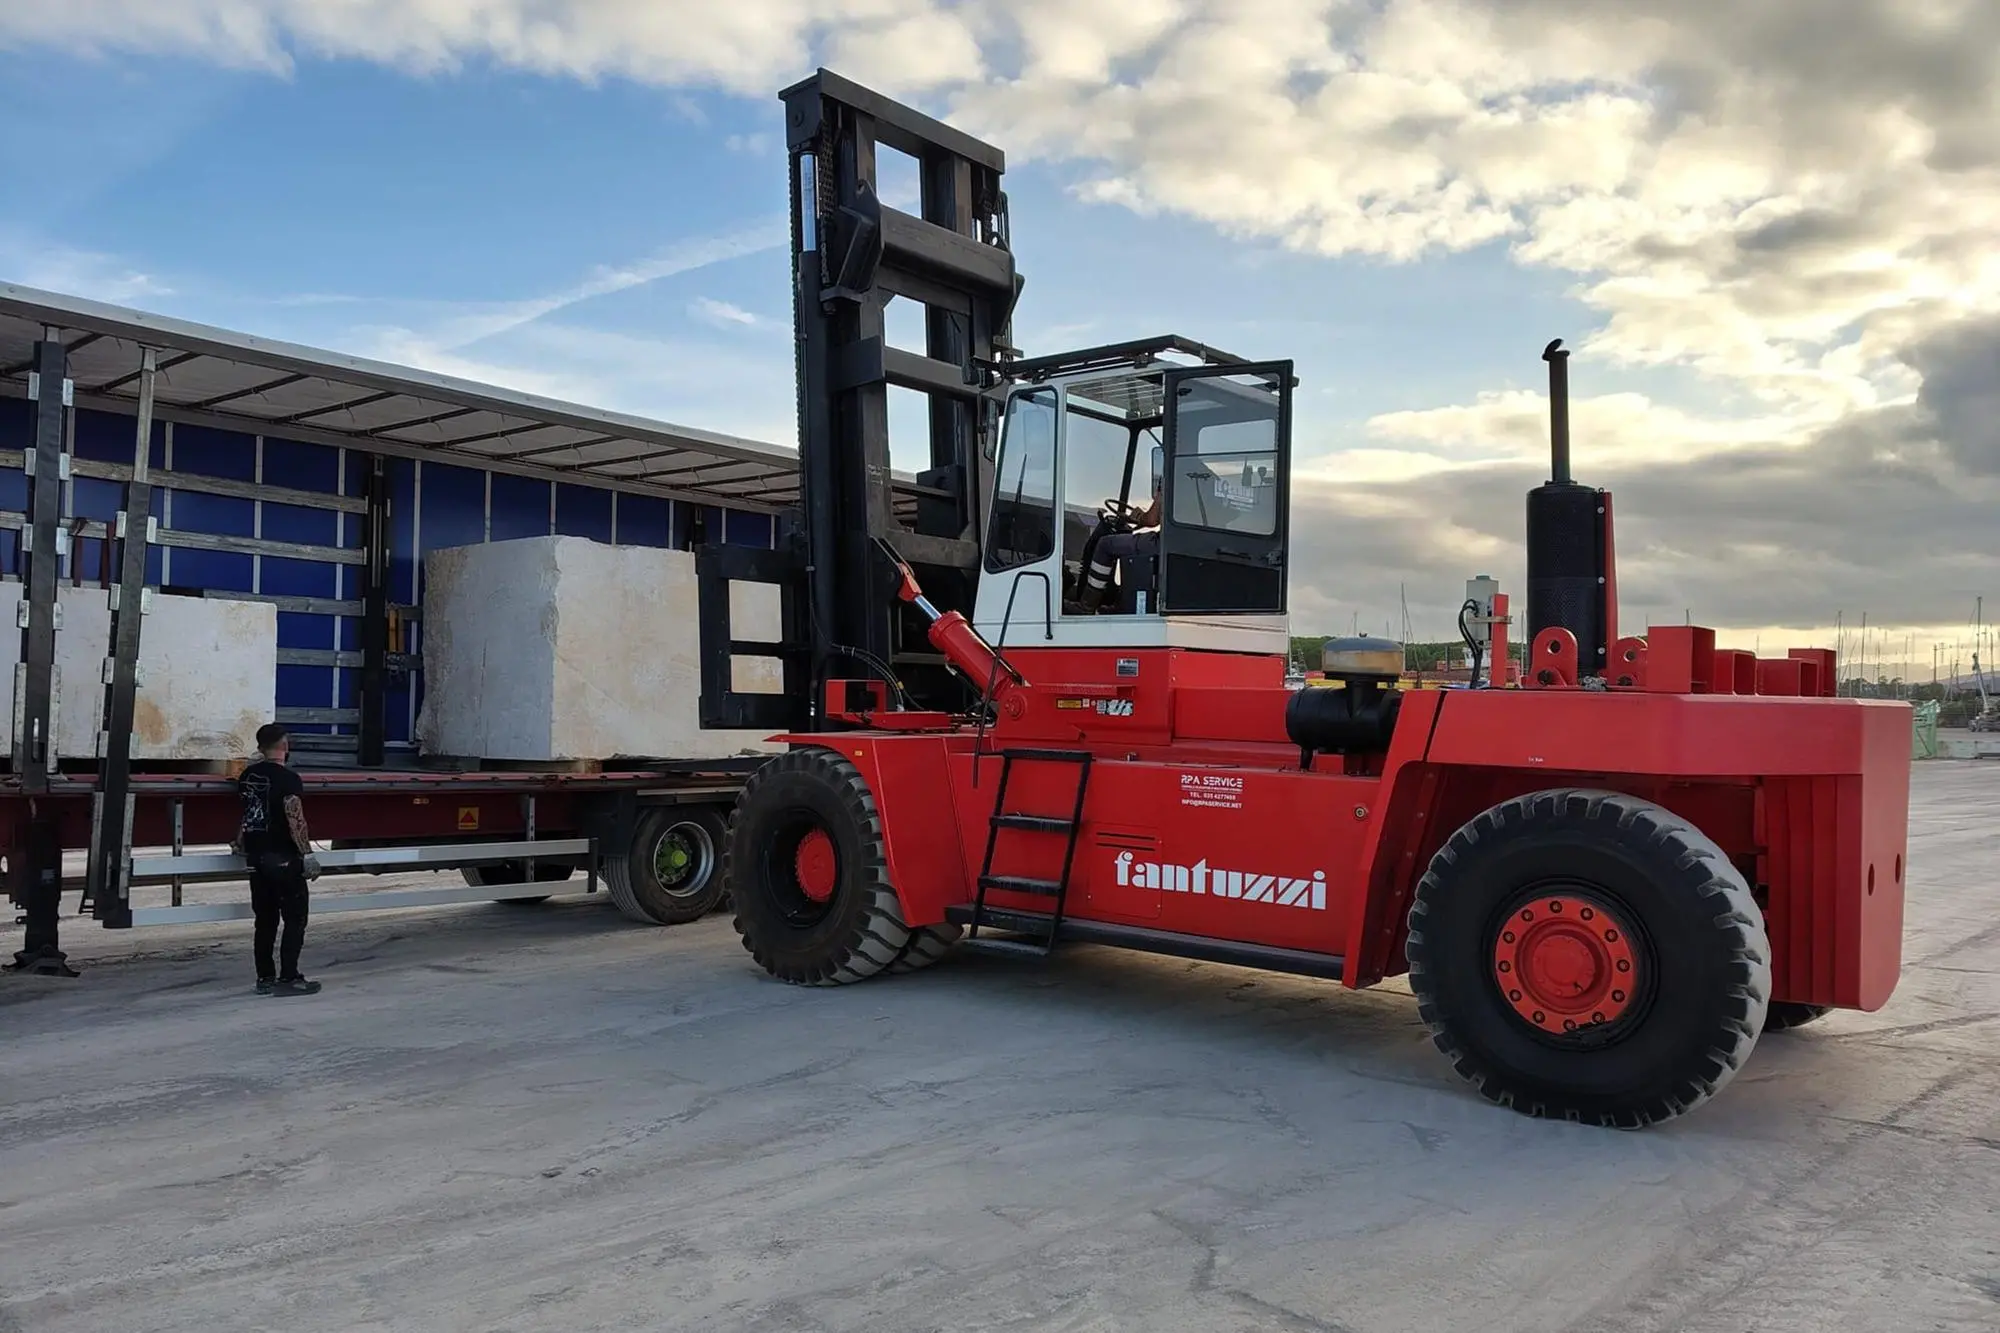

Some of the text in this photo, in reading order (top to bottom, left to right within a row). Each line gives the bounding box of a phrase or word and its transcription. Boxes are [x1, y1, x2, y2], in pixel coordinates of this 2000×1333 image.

[1181, 775, 1243, 788] RPA SERVICE
[1114, 850, 1327, 910] fantuzzi
